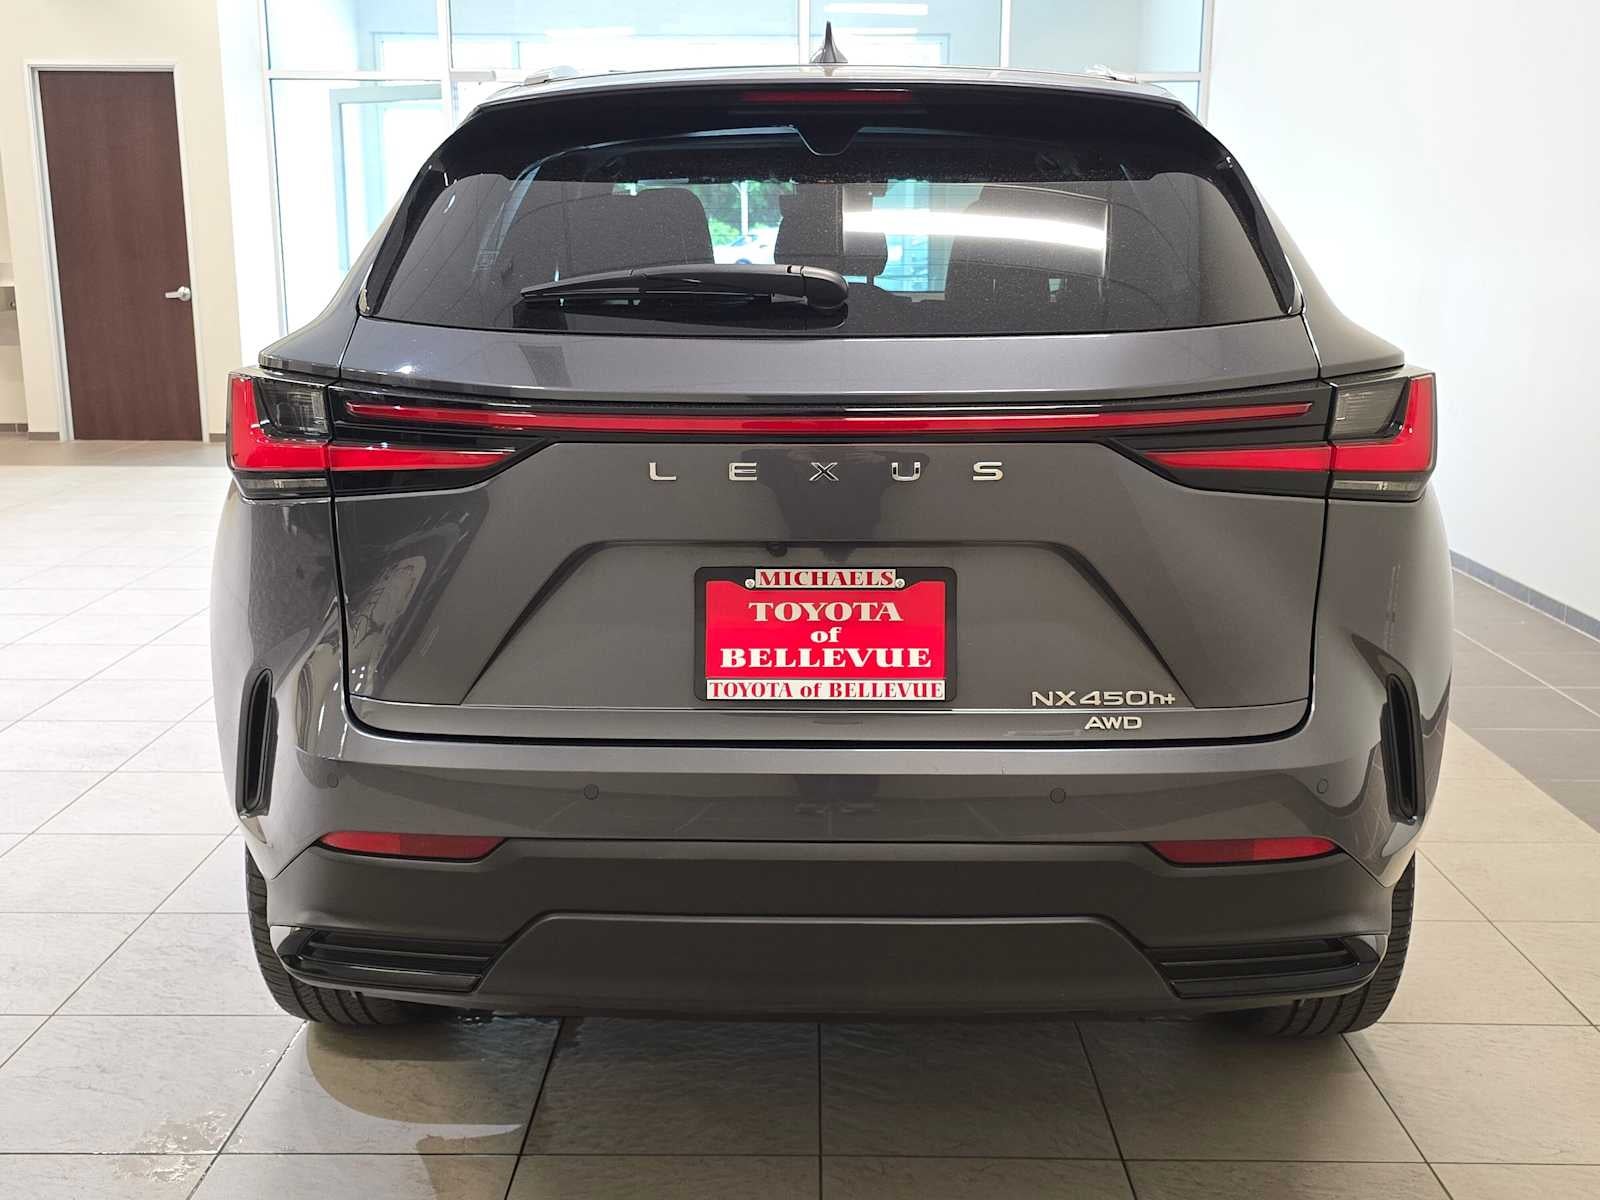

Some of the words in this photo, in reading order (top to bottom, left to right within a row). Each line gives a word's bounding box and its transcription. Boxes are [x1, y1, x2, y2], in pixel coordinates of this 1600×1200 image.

[649, 461, 1004, 482] LEXUS
[759, 570, 893, 586] MICHAELS
[748, 601, 904, 622] TOYOTA
[809, 626, 842, 643] of
[719, 647, 932, 668] BELLEVUE
[709, 681, 793, 698] TOYOTA
[800, 681, 823, 698] of
[828, 681, 944, 698] BELLEVUE
[1084, 716, 1143, 730] AWD
